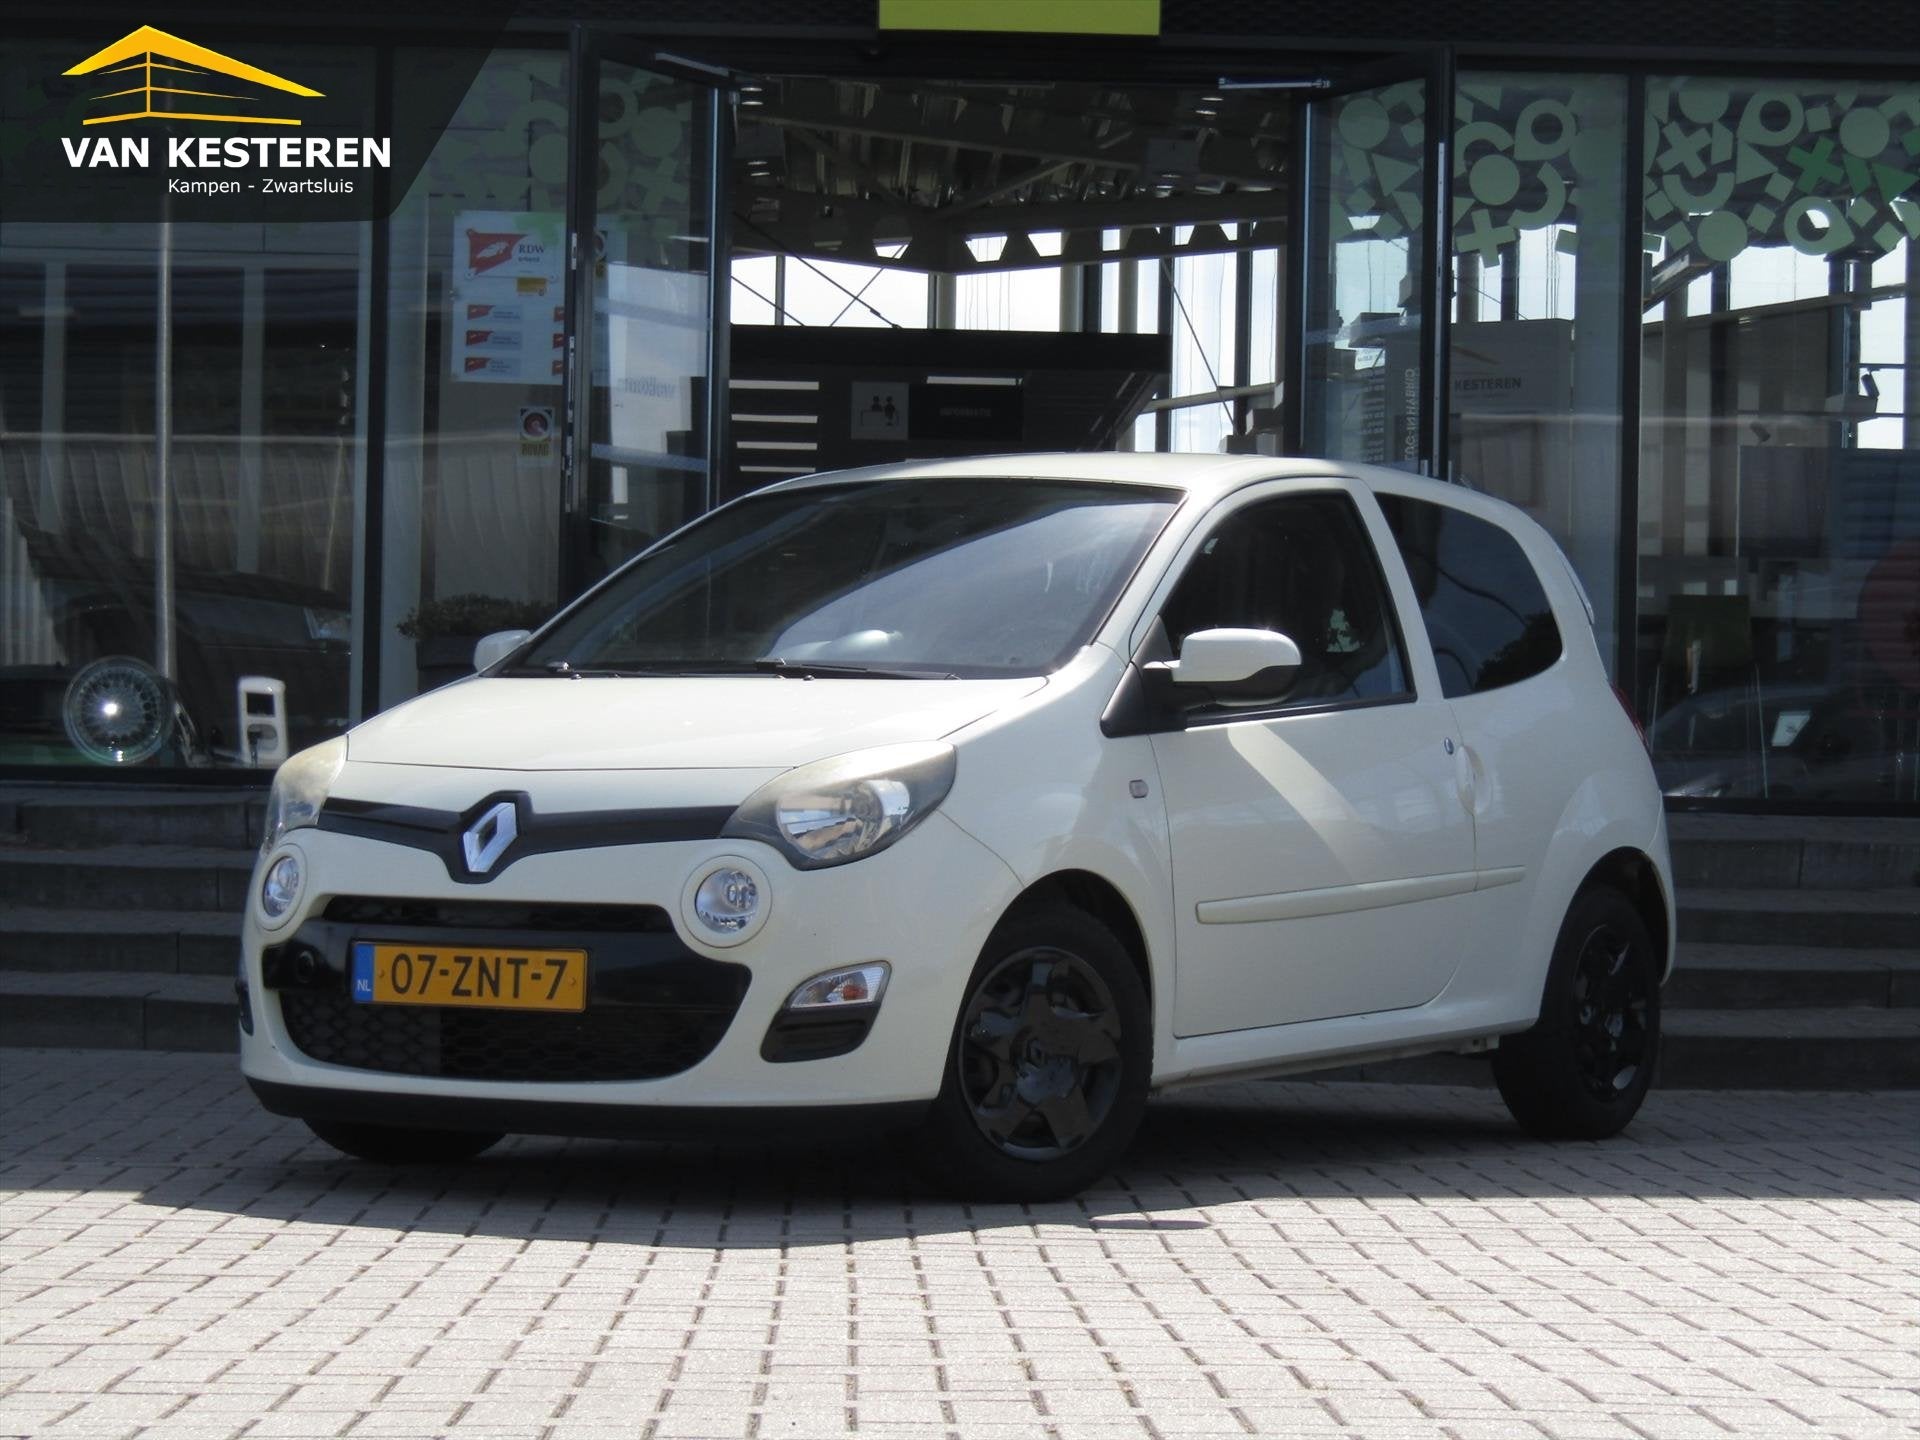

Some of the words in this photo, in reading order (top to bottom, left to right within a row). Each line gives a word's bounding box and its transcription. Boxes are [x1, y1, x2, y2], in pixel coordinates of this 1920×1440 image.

[519, 244, 545, 254] RDW
[1454, 376, 1521, 391] KESTEREN
[390, 953, 568, 1000] 07-ZNT-7
[357, 979, 371, 992] NL
